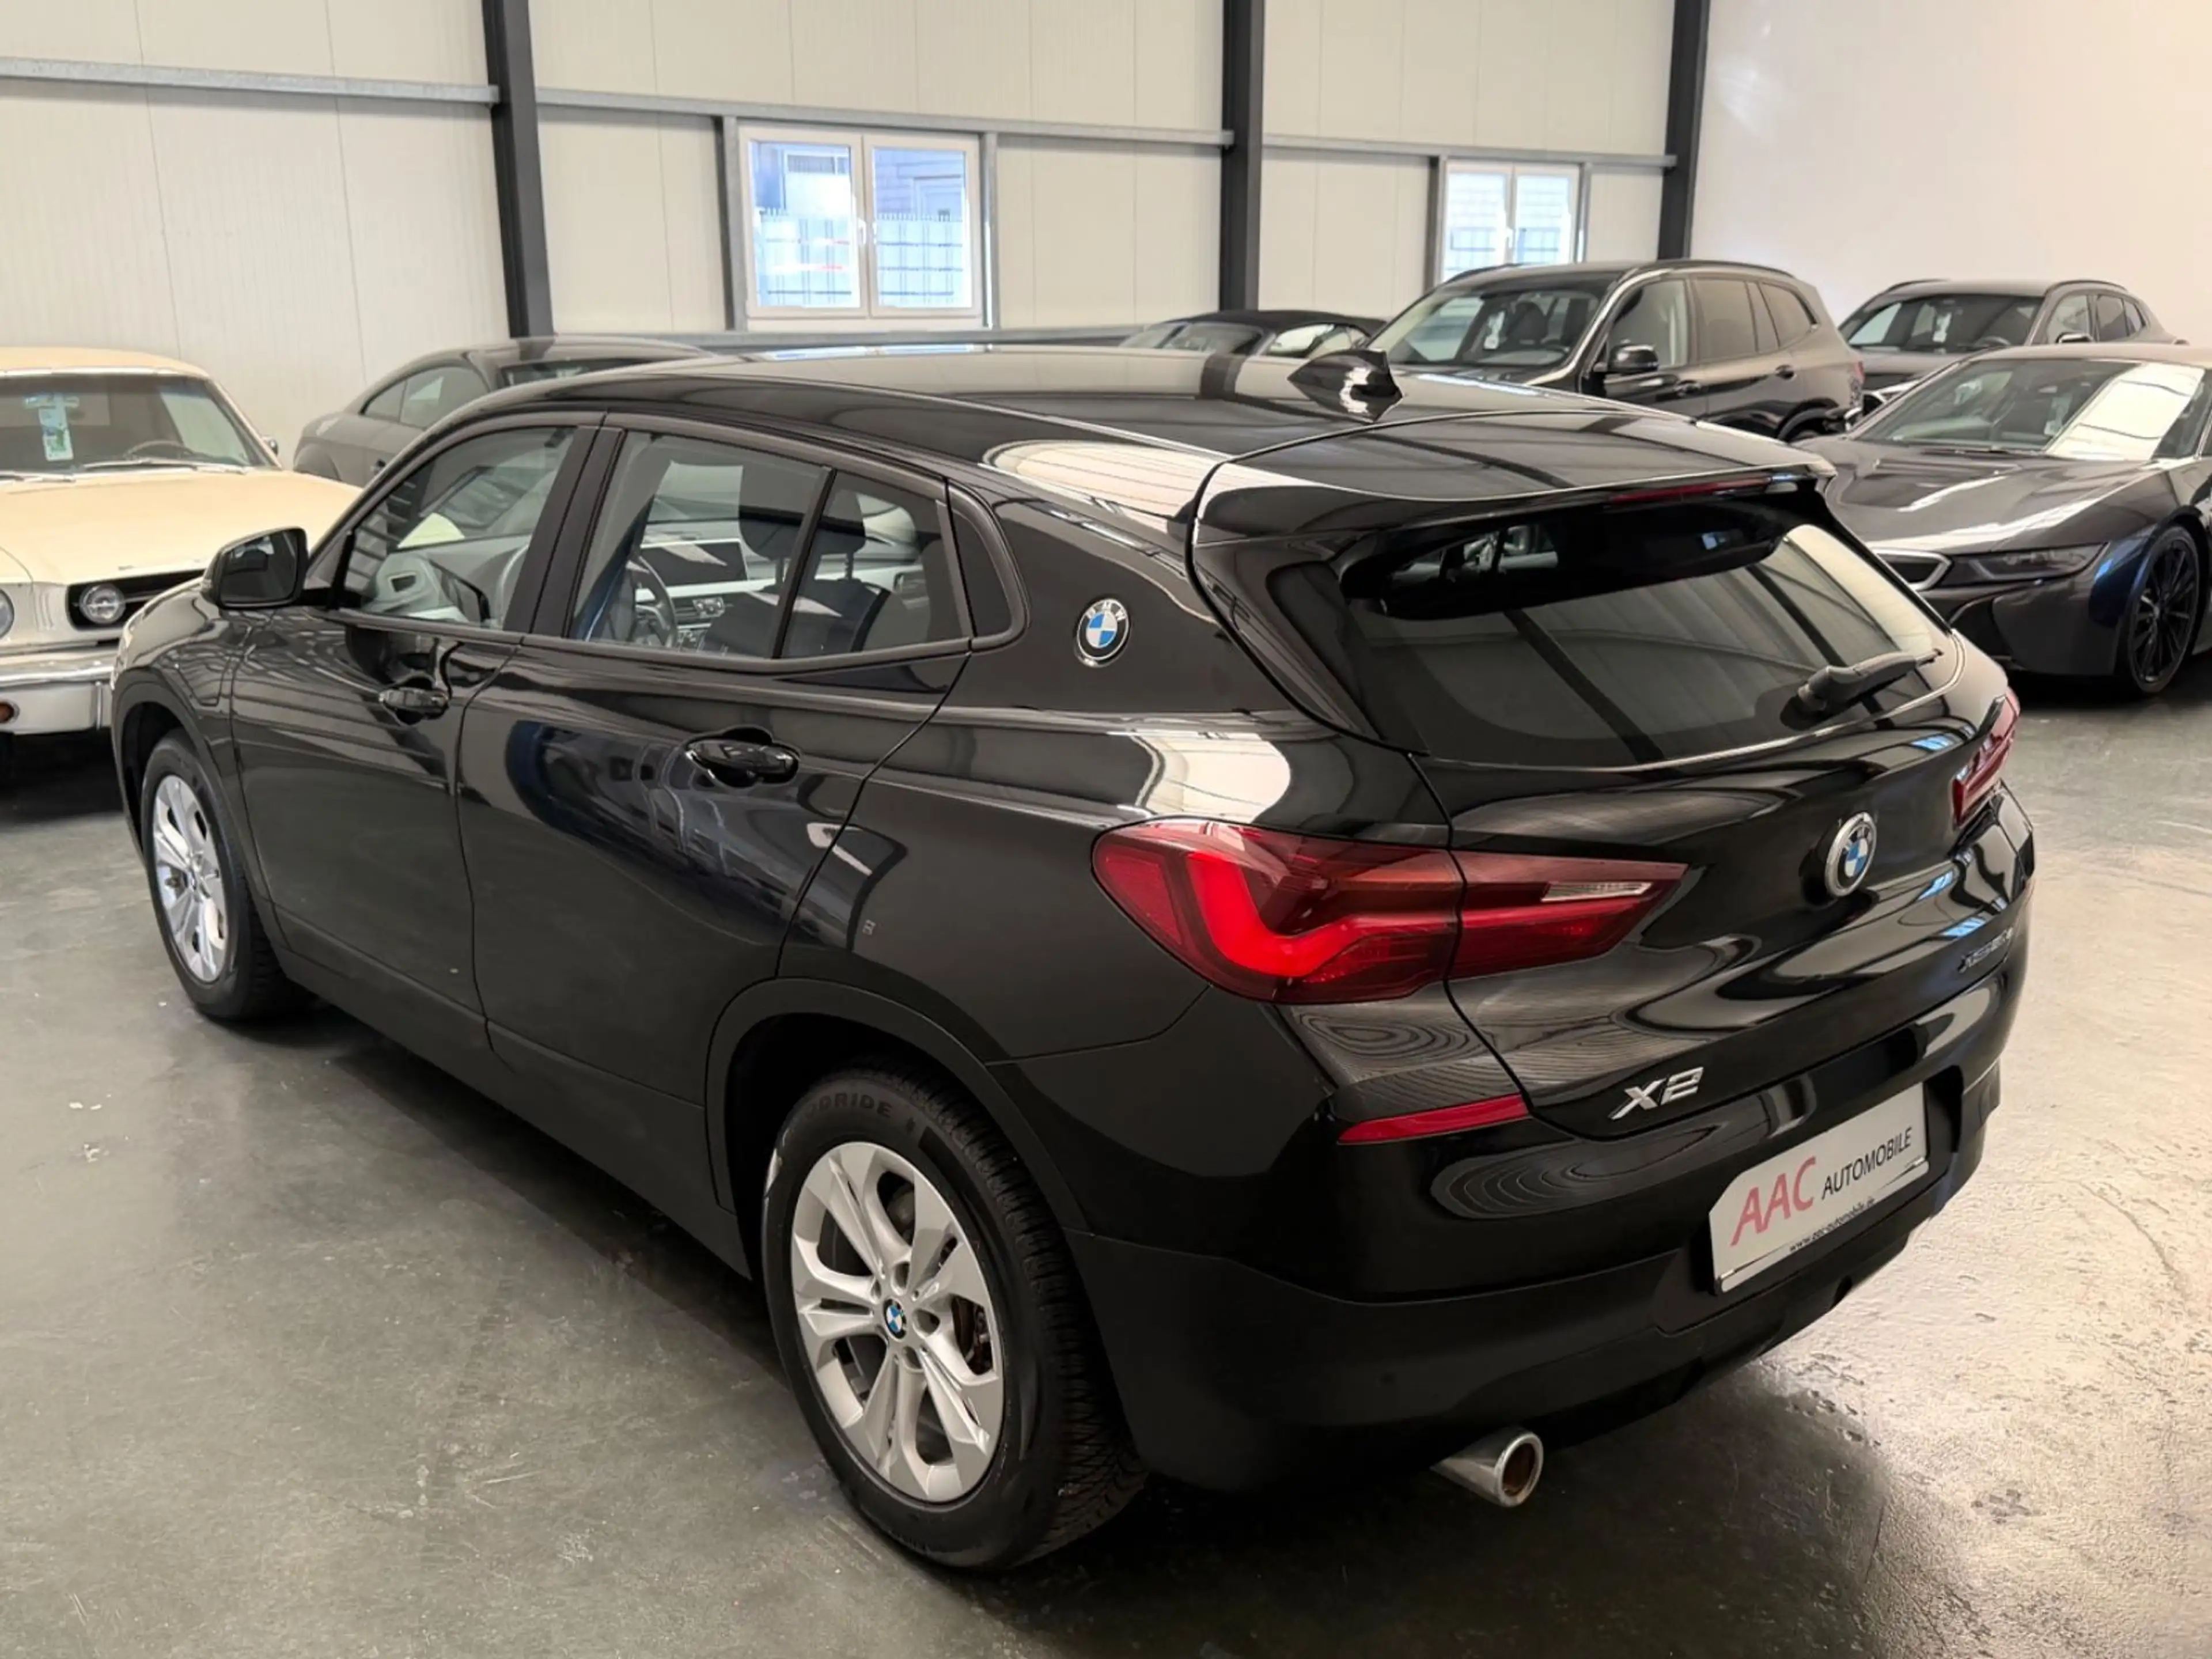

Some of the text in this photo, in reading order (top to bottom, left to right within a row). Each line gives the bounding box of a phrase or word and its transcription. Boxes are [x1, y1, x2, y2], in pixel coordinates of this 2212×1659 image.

[1608, 1066, 1703, 1120] X2
[1729, 1126, 1912, 1247] AAC AUTOMOBILE
